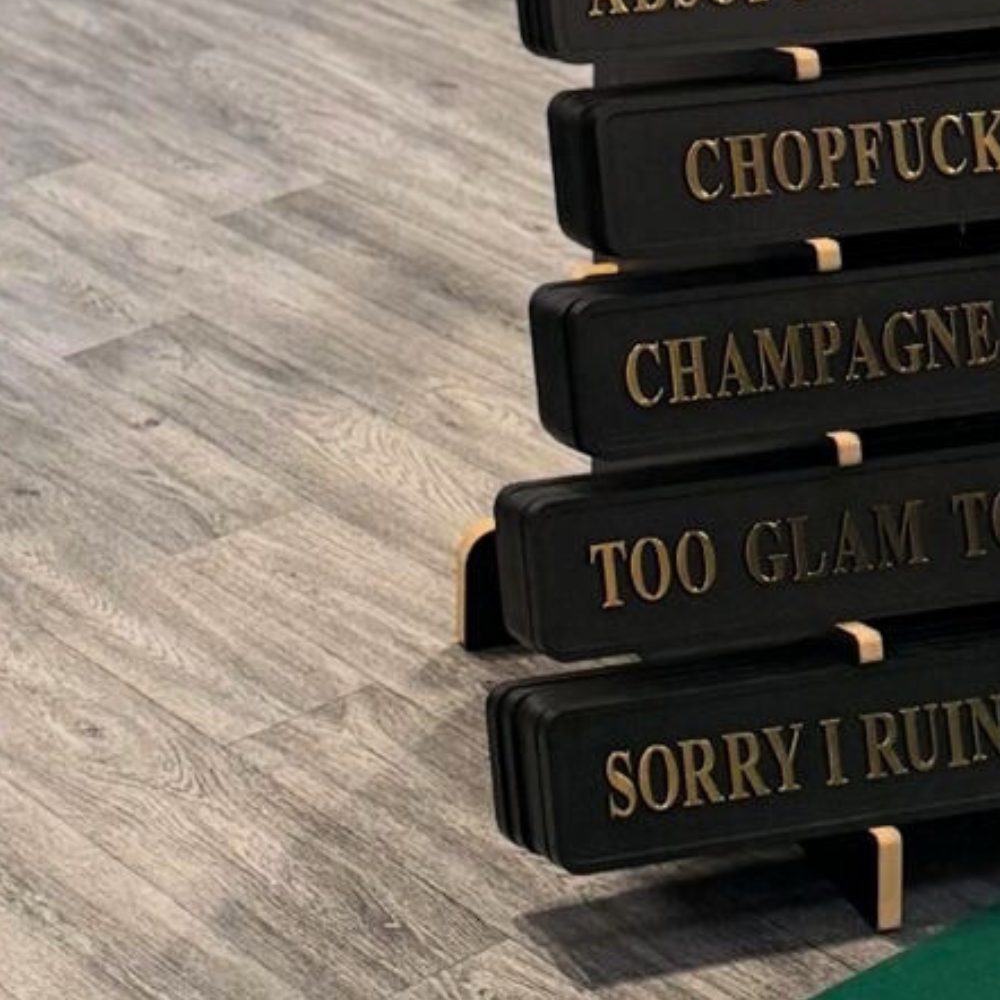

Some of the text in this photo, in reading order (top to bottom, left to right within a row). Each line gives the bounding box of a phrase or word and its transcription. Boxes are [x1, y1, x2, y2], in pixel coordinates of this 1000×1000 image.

[624, 301, 1000, 409] CHAMPAGNE
[590, 529, 717, 610] TOO
[744, 499, 930, 585] GLAM
[605, 721, 803, 817] SORRY
[821, 717, 848, 785] I
